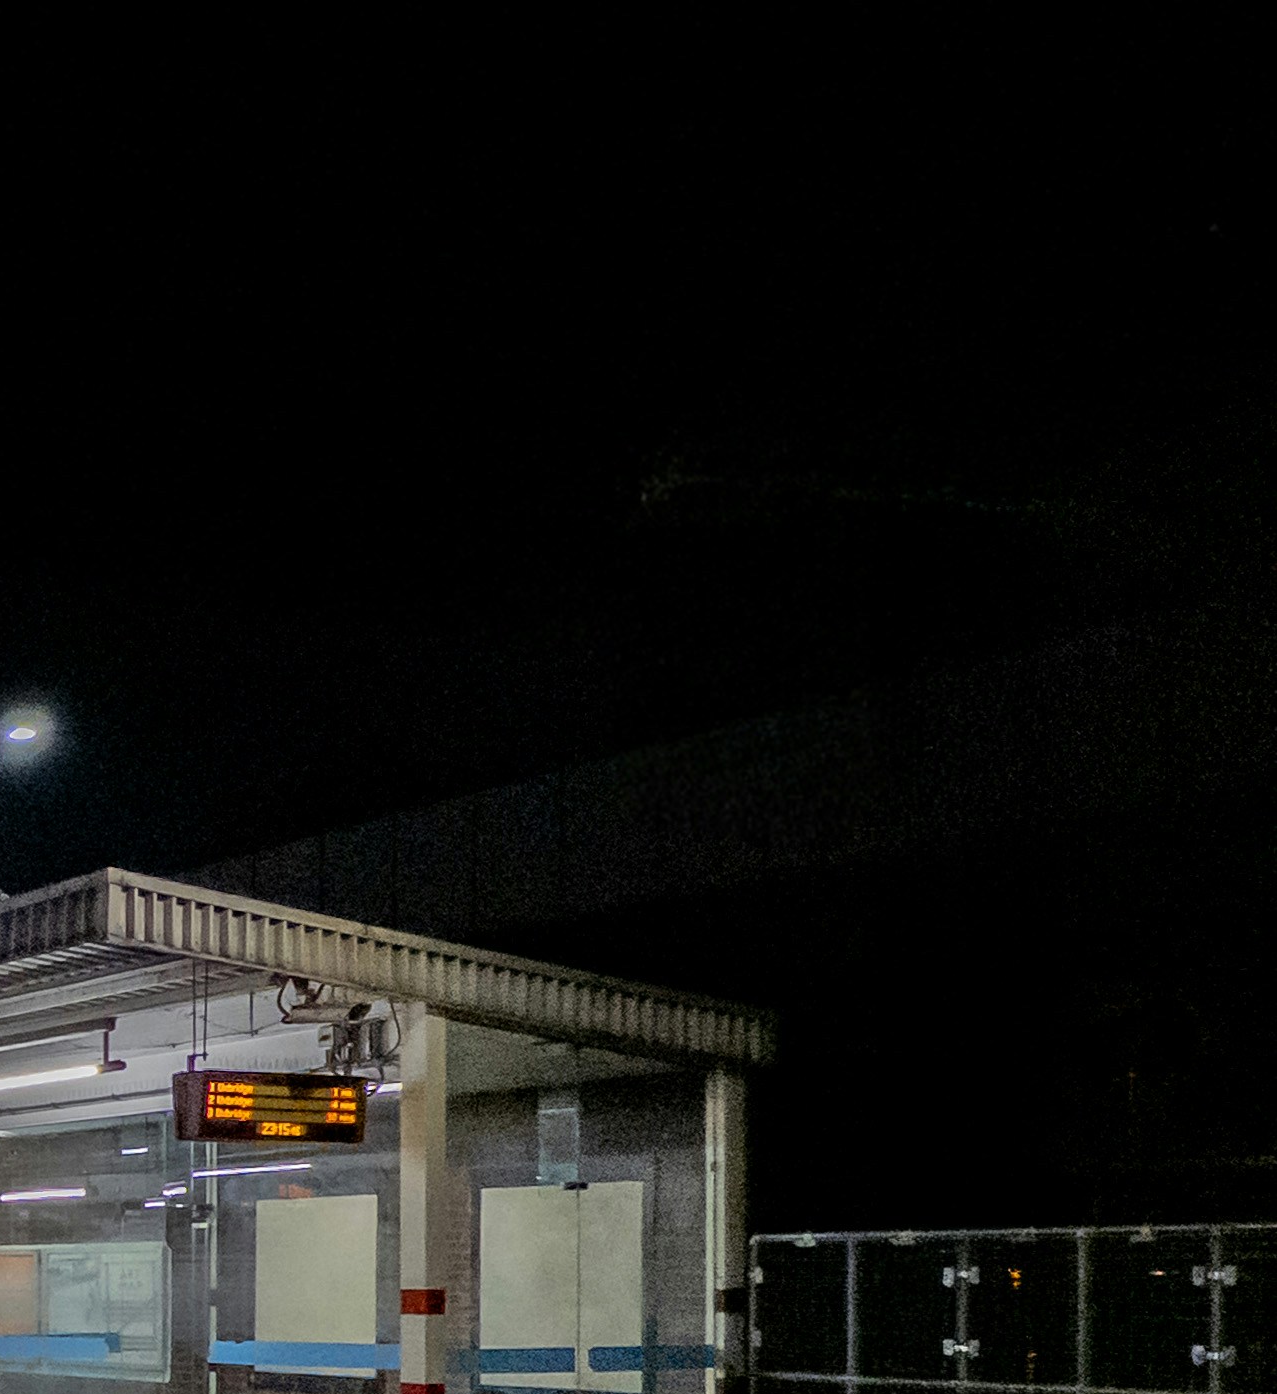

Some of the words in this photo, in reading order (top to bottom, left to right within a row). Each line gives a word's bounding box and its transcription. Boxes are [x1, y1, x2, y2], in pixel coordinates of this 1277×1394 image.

[217, 1082, 253, 1095] Uxbridge
[208, 1094, 215, 1105] 2
[216, 1095, 253, 1107] Uxbridge
[215, 1108, 252, 1121] Uxbridge
